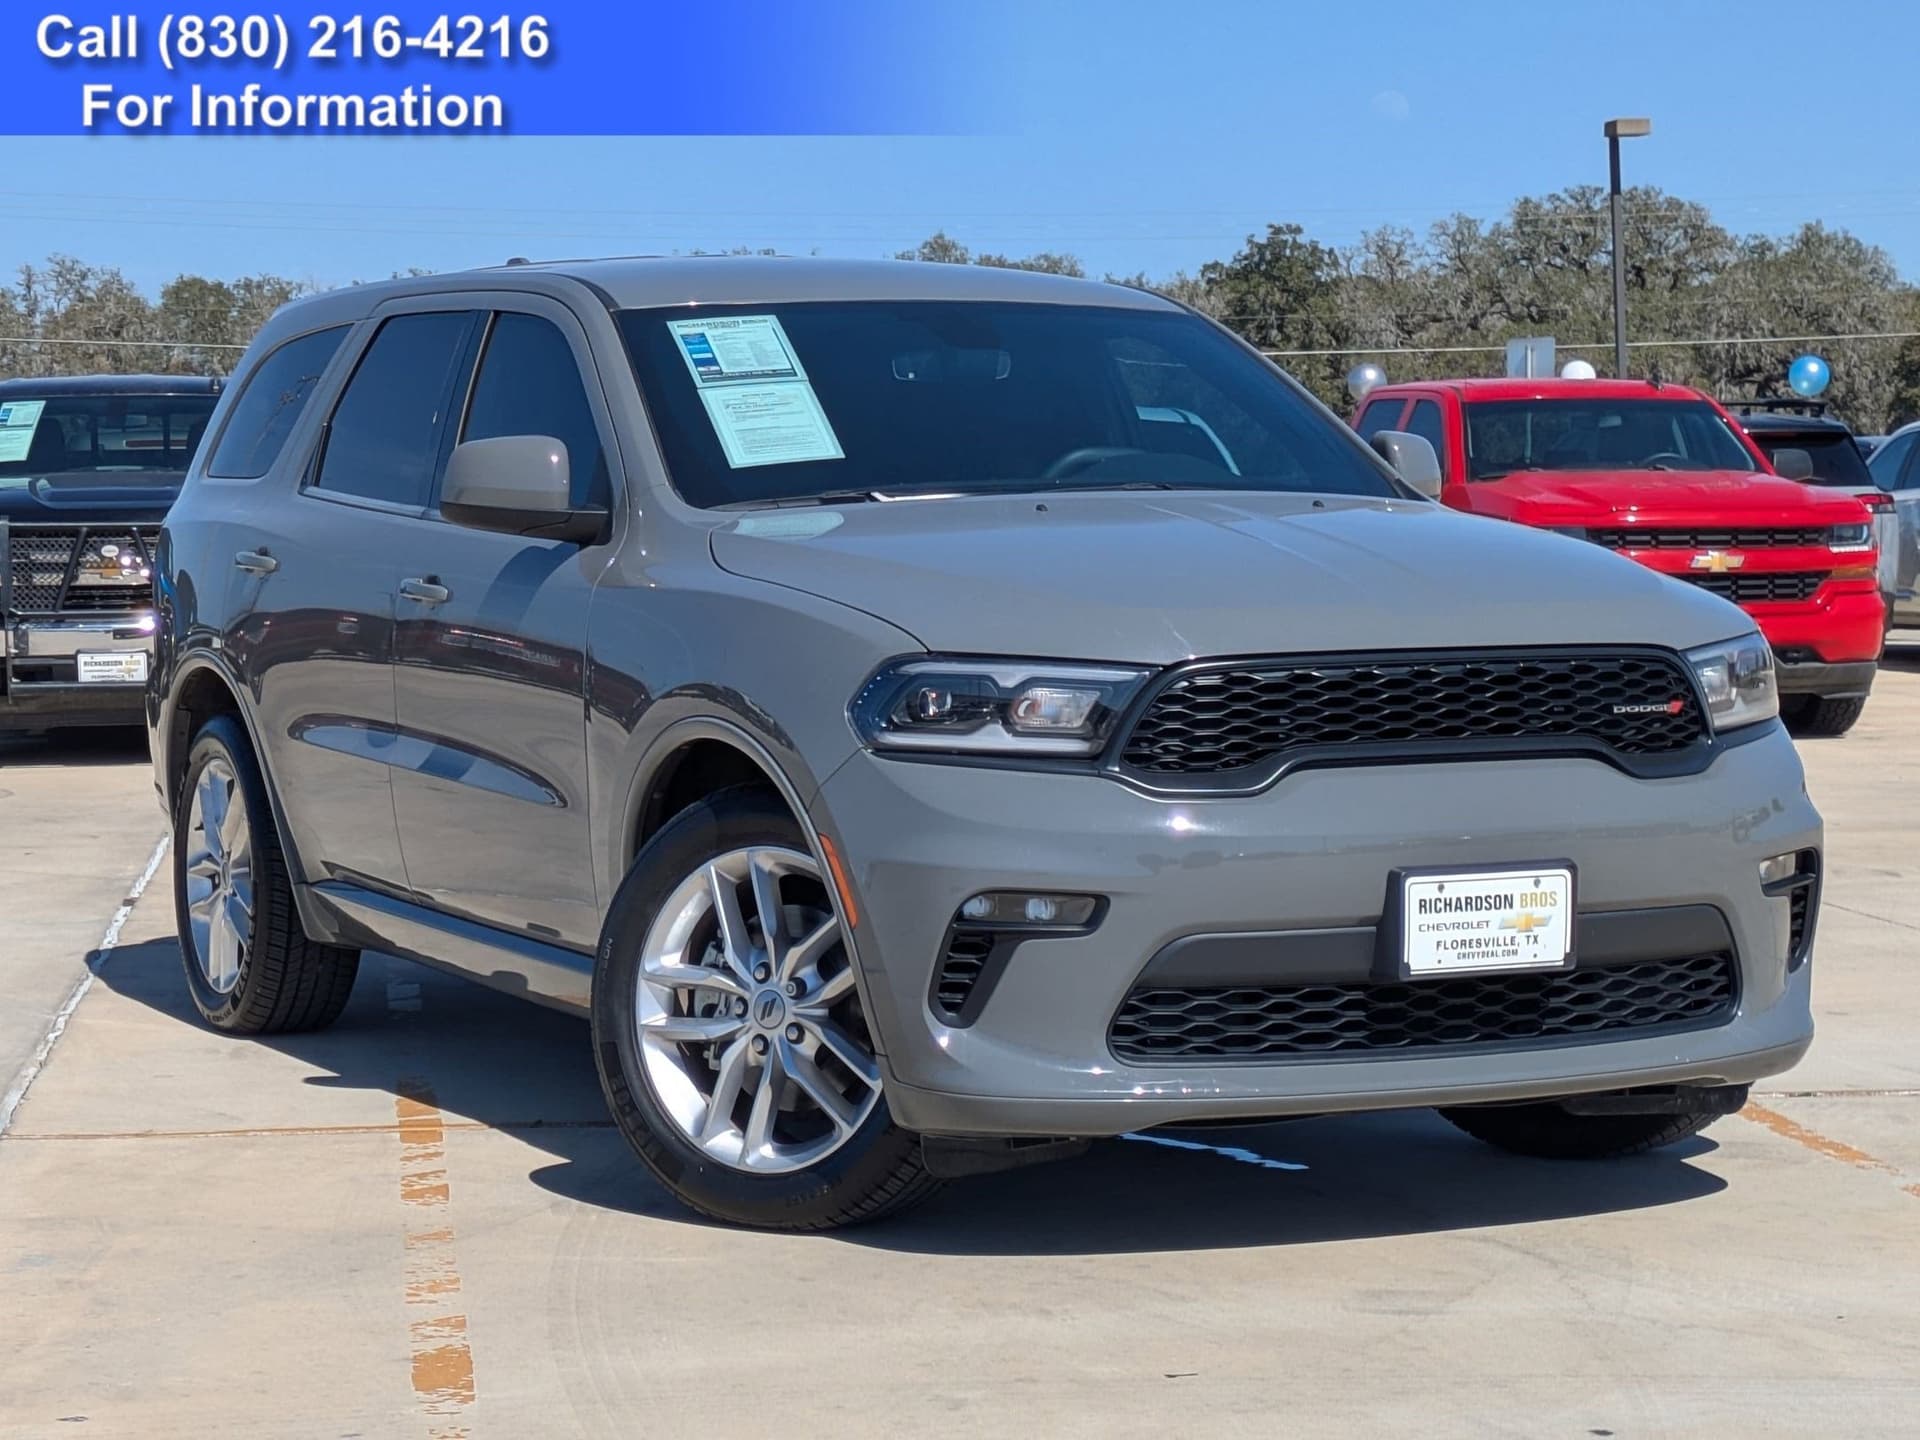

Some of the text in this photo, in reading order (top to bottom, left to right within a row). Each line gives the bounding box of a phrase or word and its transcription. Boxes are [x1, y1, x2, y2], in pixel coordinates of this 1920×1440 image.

[1613, 704, 1672, 713] DODGE
[1418, 891, 1558, 915] RICHARDSON BROS
[1418, 920, 1491, 933] CHEVROLET
[1436, 934, 1540, 952] FLORESVILLE, TX
[1456, 948, 1519, 961] CHEVYDEAL.COM
